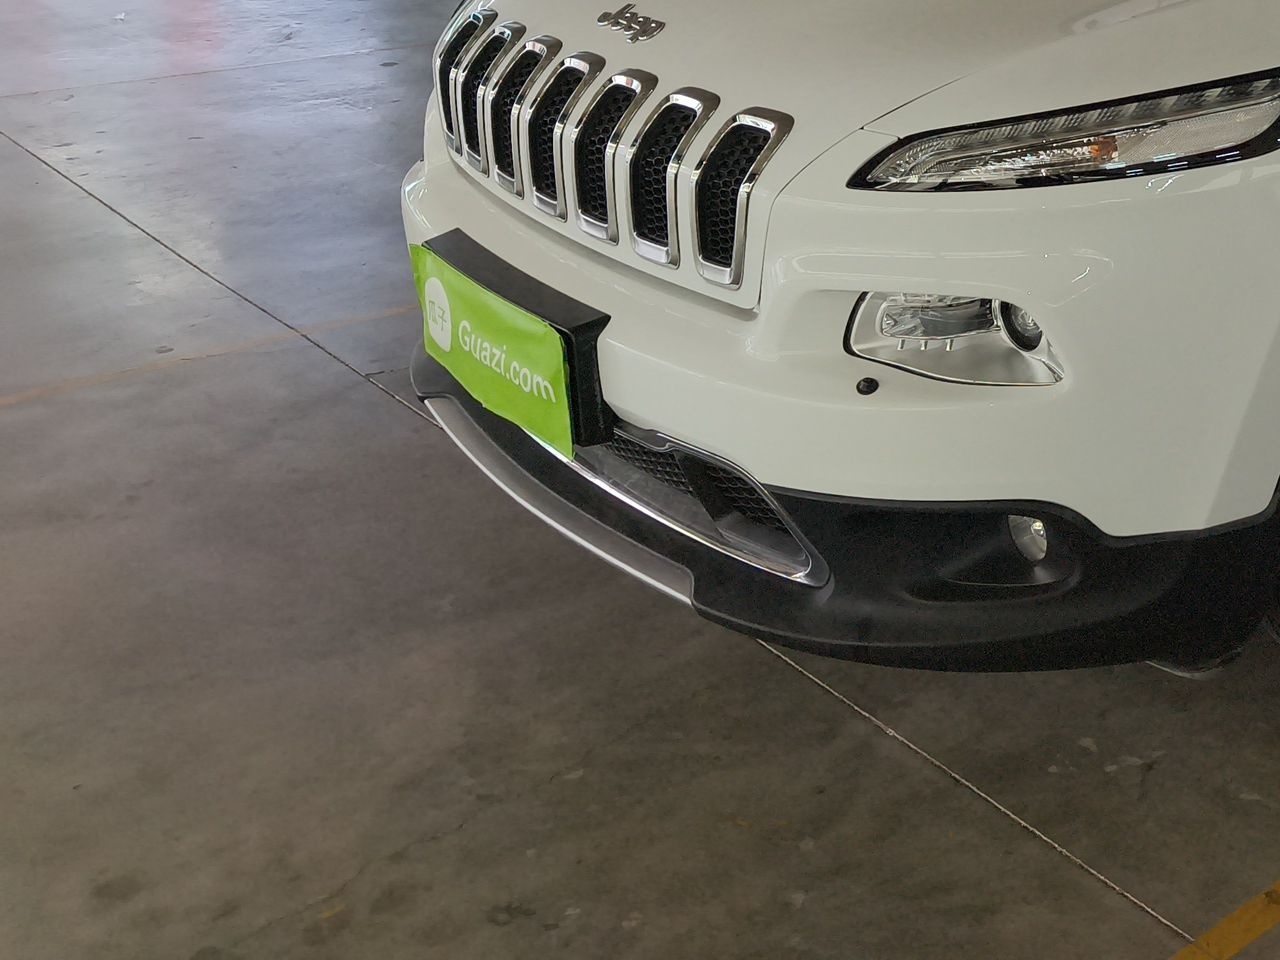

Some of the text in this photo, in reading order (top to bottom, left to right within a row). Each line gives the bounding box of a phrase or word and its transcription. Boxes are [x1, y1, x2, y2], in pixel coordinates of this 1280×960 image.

[597, 3, 665, 43] Jeep
[428, 299, 448, 331] 瓜子
[458, 320, 557, 404] Guazi.com
